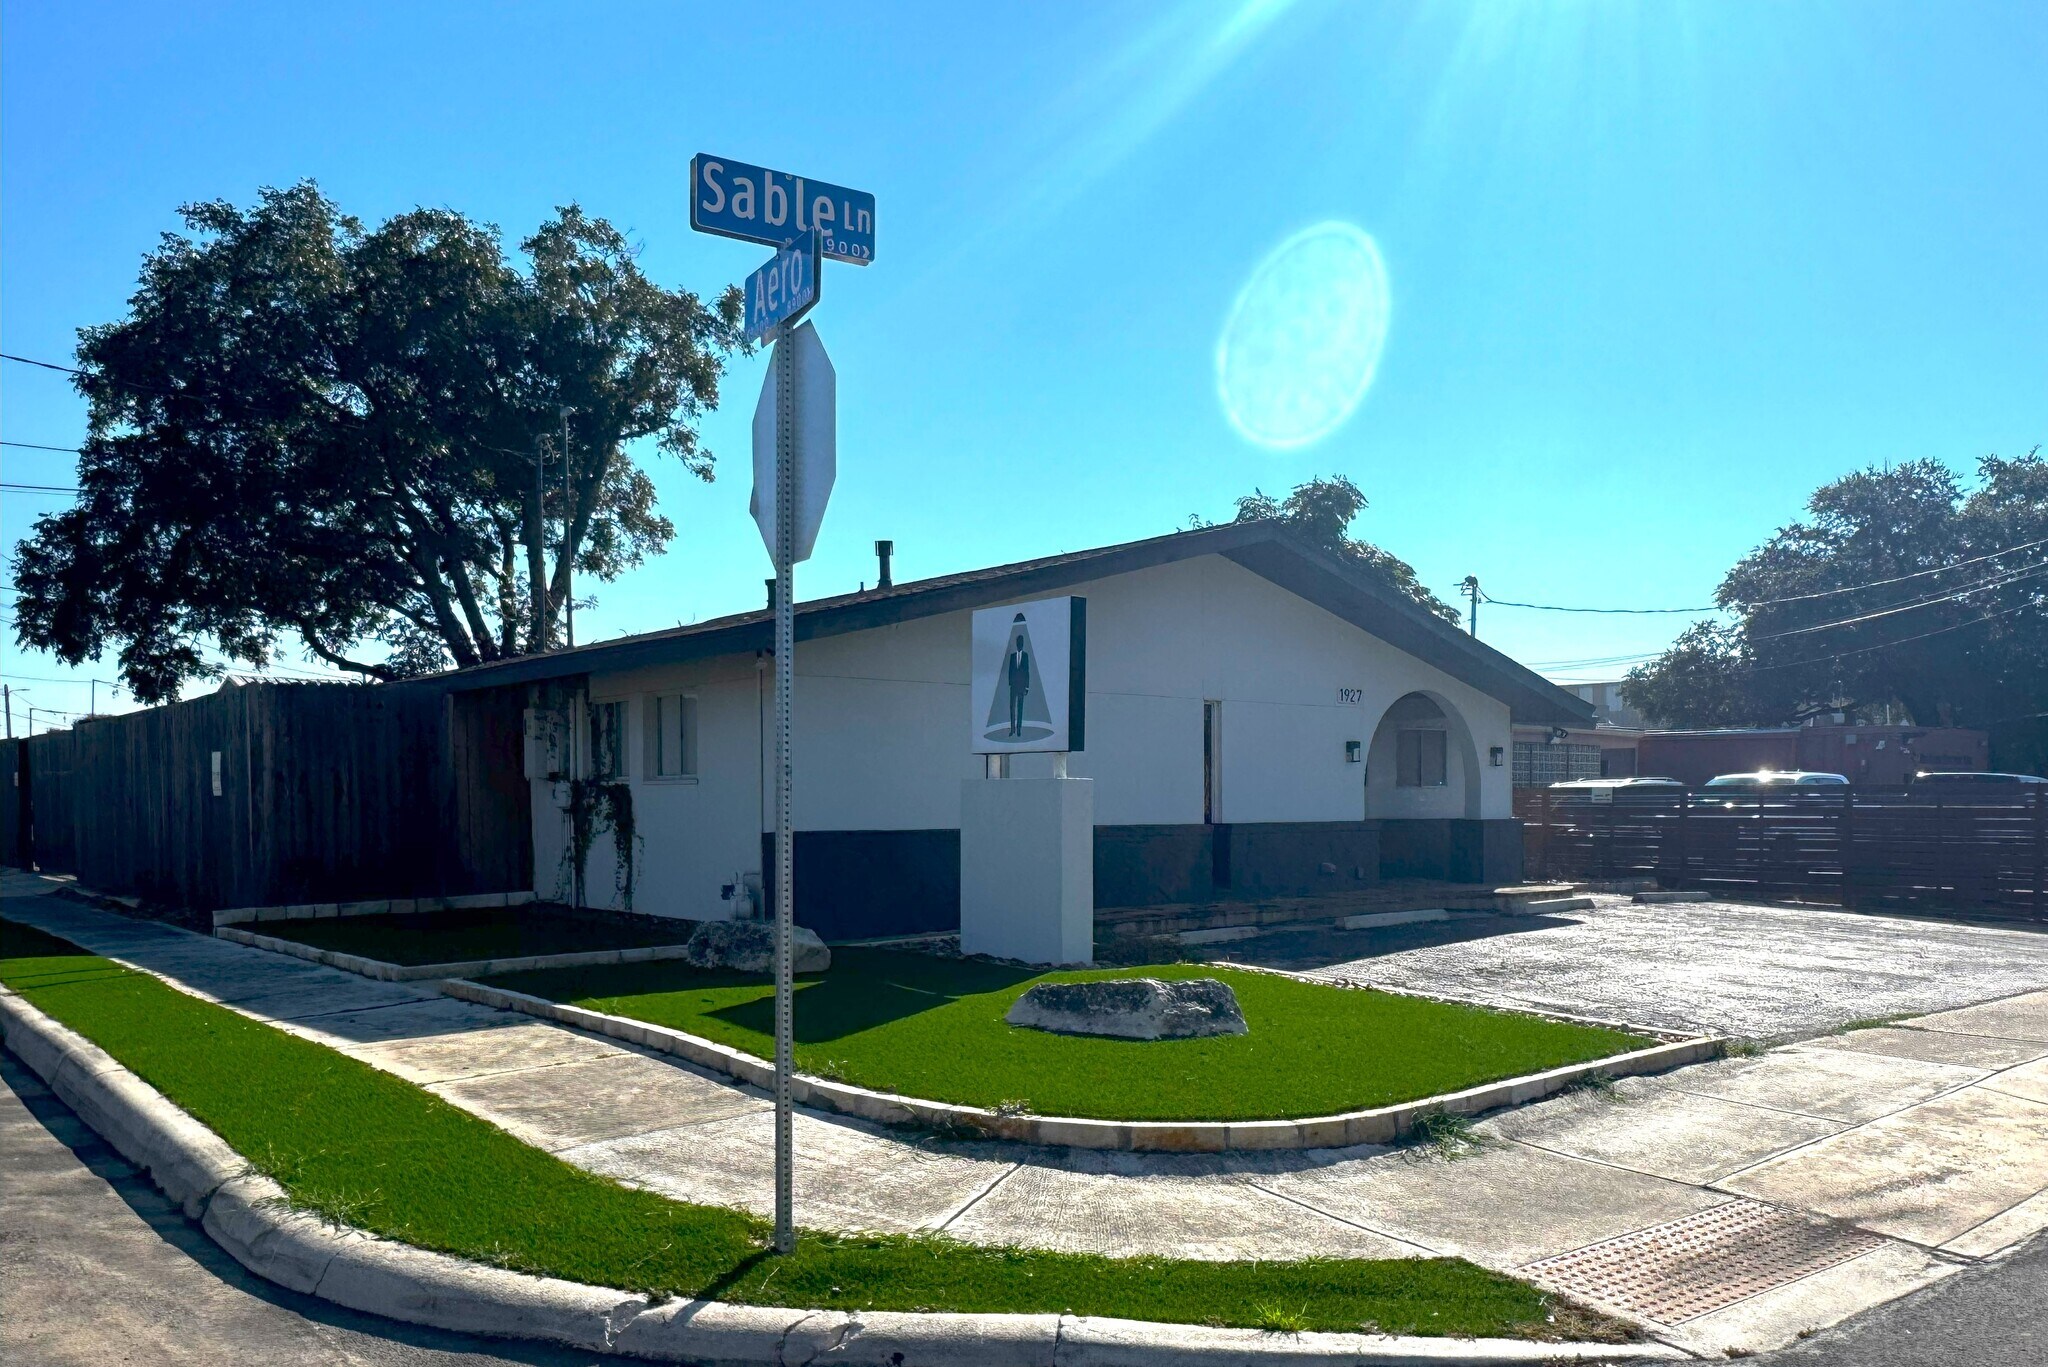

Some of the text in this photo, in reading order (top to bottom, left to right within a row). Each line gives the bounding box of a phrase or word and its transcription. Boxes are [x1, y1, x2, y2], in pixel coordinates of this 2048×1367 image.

[702, 161, 871, 237] Sable Ln
[753, 248, 803, 324] Aero
[1339, 688, 1363, 703] 1927
